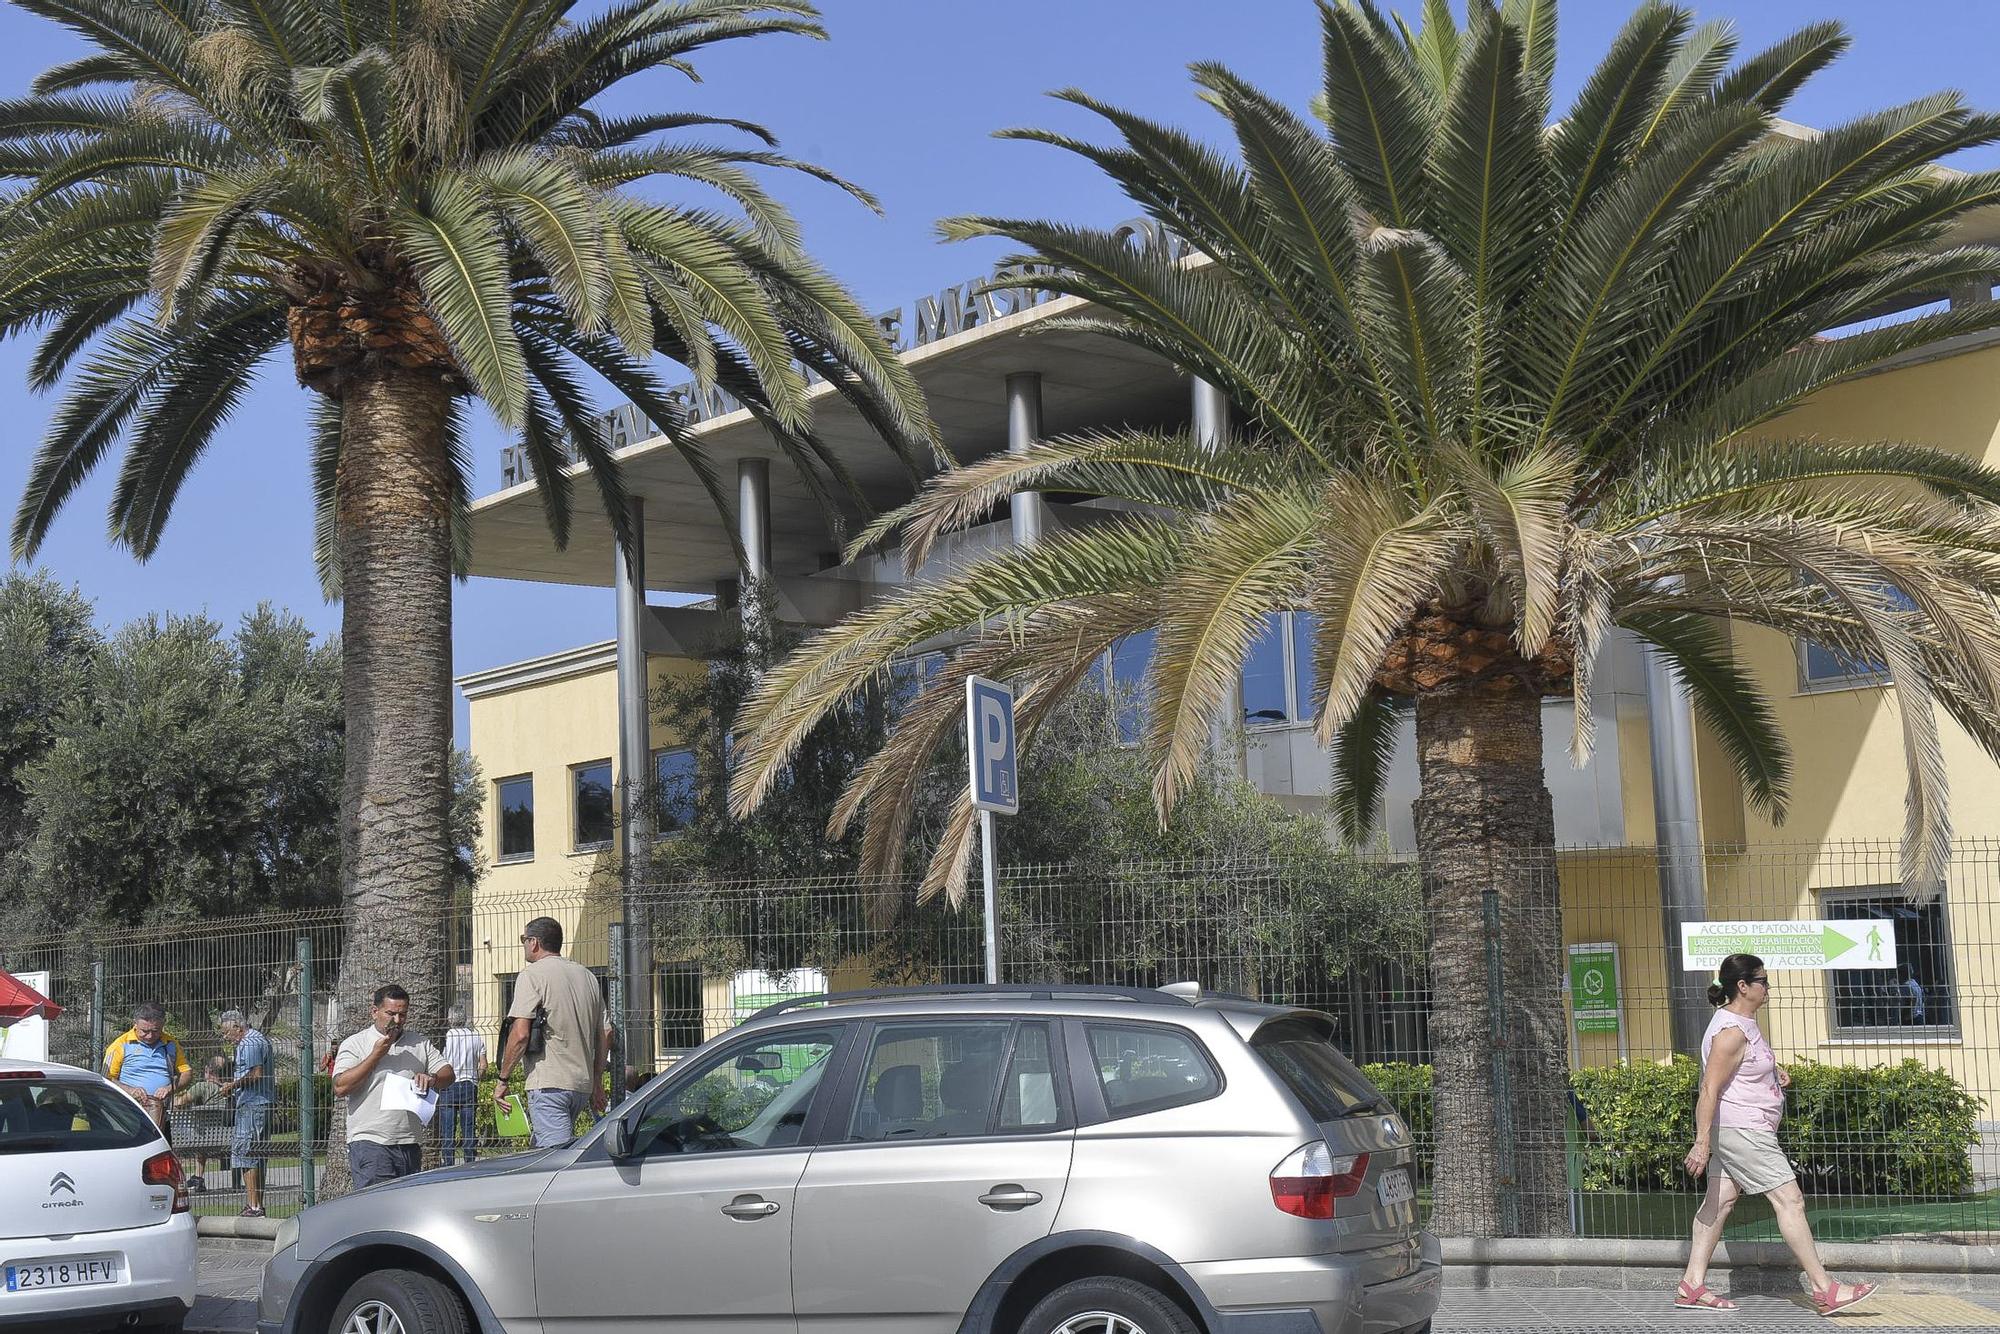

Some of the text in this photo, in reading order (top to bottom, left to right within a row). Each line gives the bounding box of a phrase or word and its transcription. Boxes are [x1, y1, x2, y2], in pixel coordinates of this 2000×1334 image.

[981, 694, 1007, 793] P
[1701, 924, 1815, 934] ACCESO PEATONAL
[1696, 937, 1742, 945] URGENCIAS
[1751, 936, 1821, 945] REHABILITACIÓN
[1696, 946, 1744, 954] EMERGENCY
[1754, 946, 1823, 954] REHABILITATION
[1779, 956, 1823, 966] ACCESS
[20, 1261, 111, 1287] 2318 HFV
